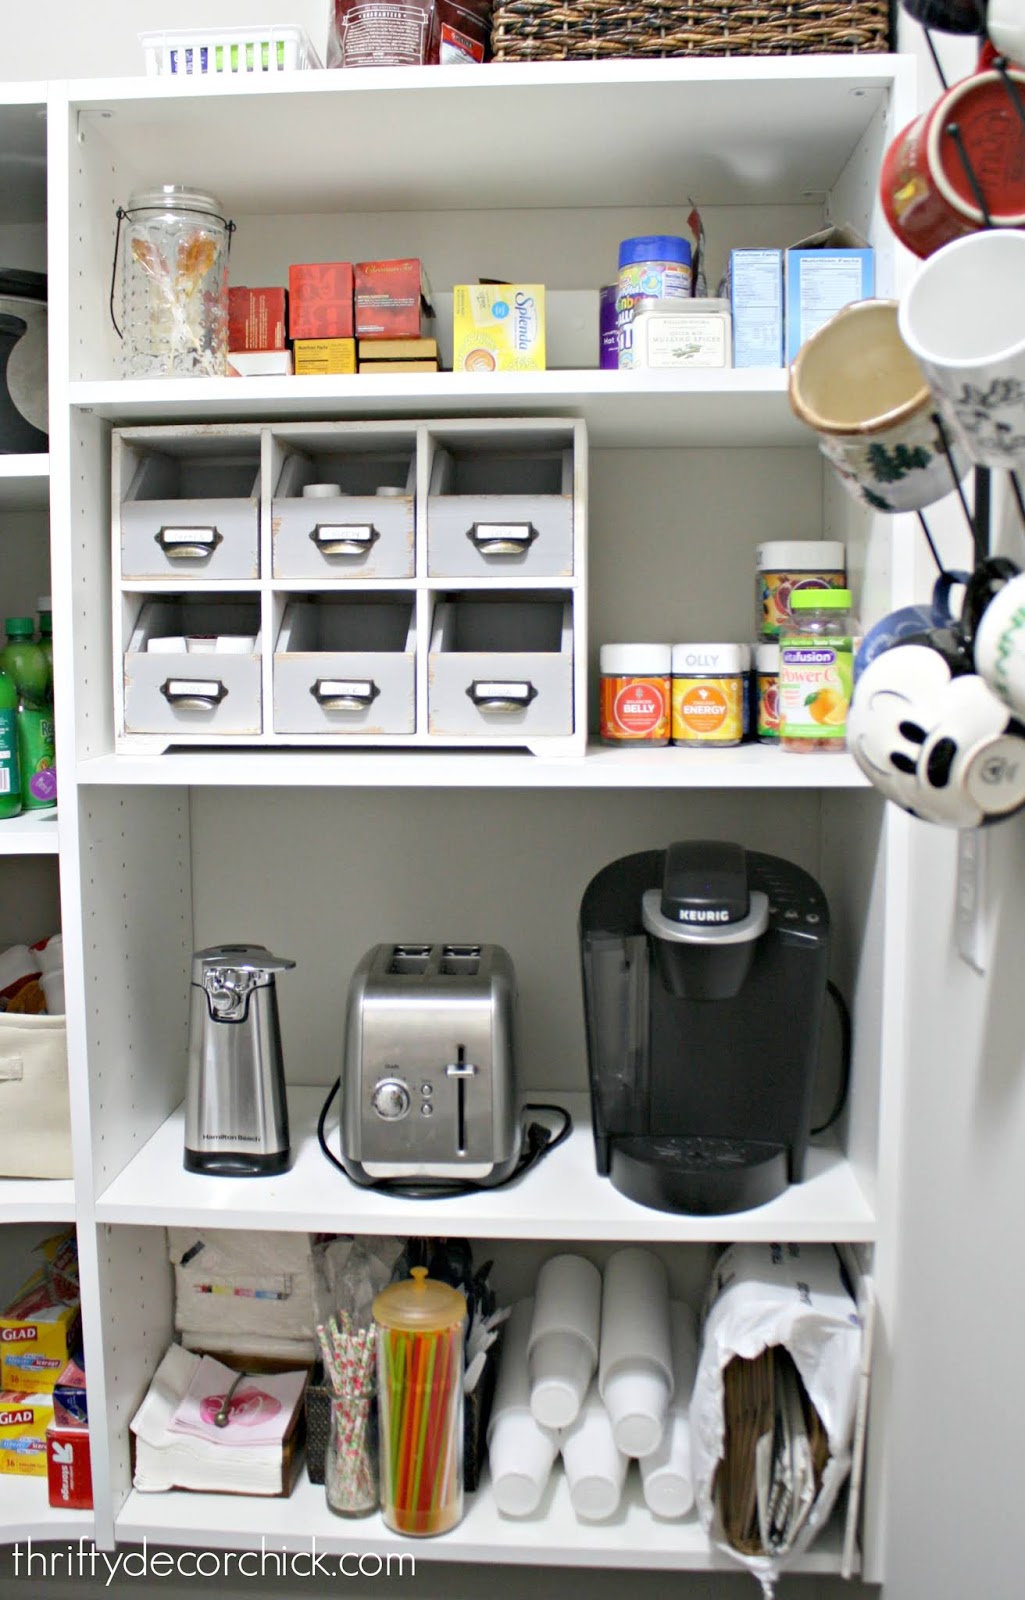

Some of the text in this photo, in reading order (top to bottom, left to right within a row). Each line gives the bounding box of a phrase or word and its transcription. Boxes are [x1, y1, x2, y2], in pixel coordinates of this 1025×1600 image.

[515, 291, 534, 350] Splenda
[685, 654, 719, 667] OLLY
[783, 652, 832, 662] vitafusion
[623, 704, 656, 713] BELLY
[683, 705, 726, 715] ENERGY
[679, 909, 730, 922] KEURIG
[2, 1328, 36, 1341] GLAD
[0, 1411, 33, 1424] GLAD
[61, 1465, 70, 1501] storage
